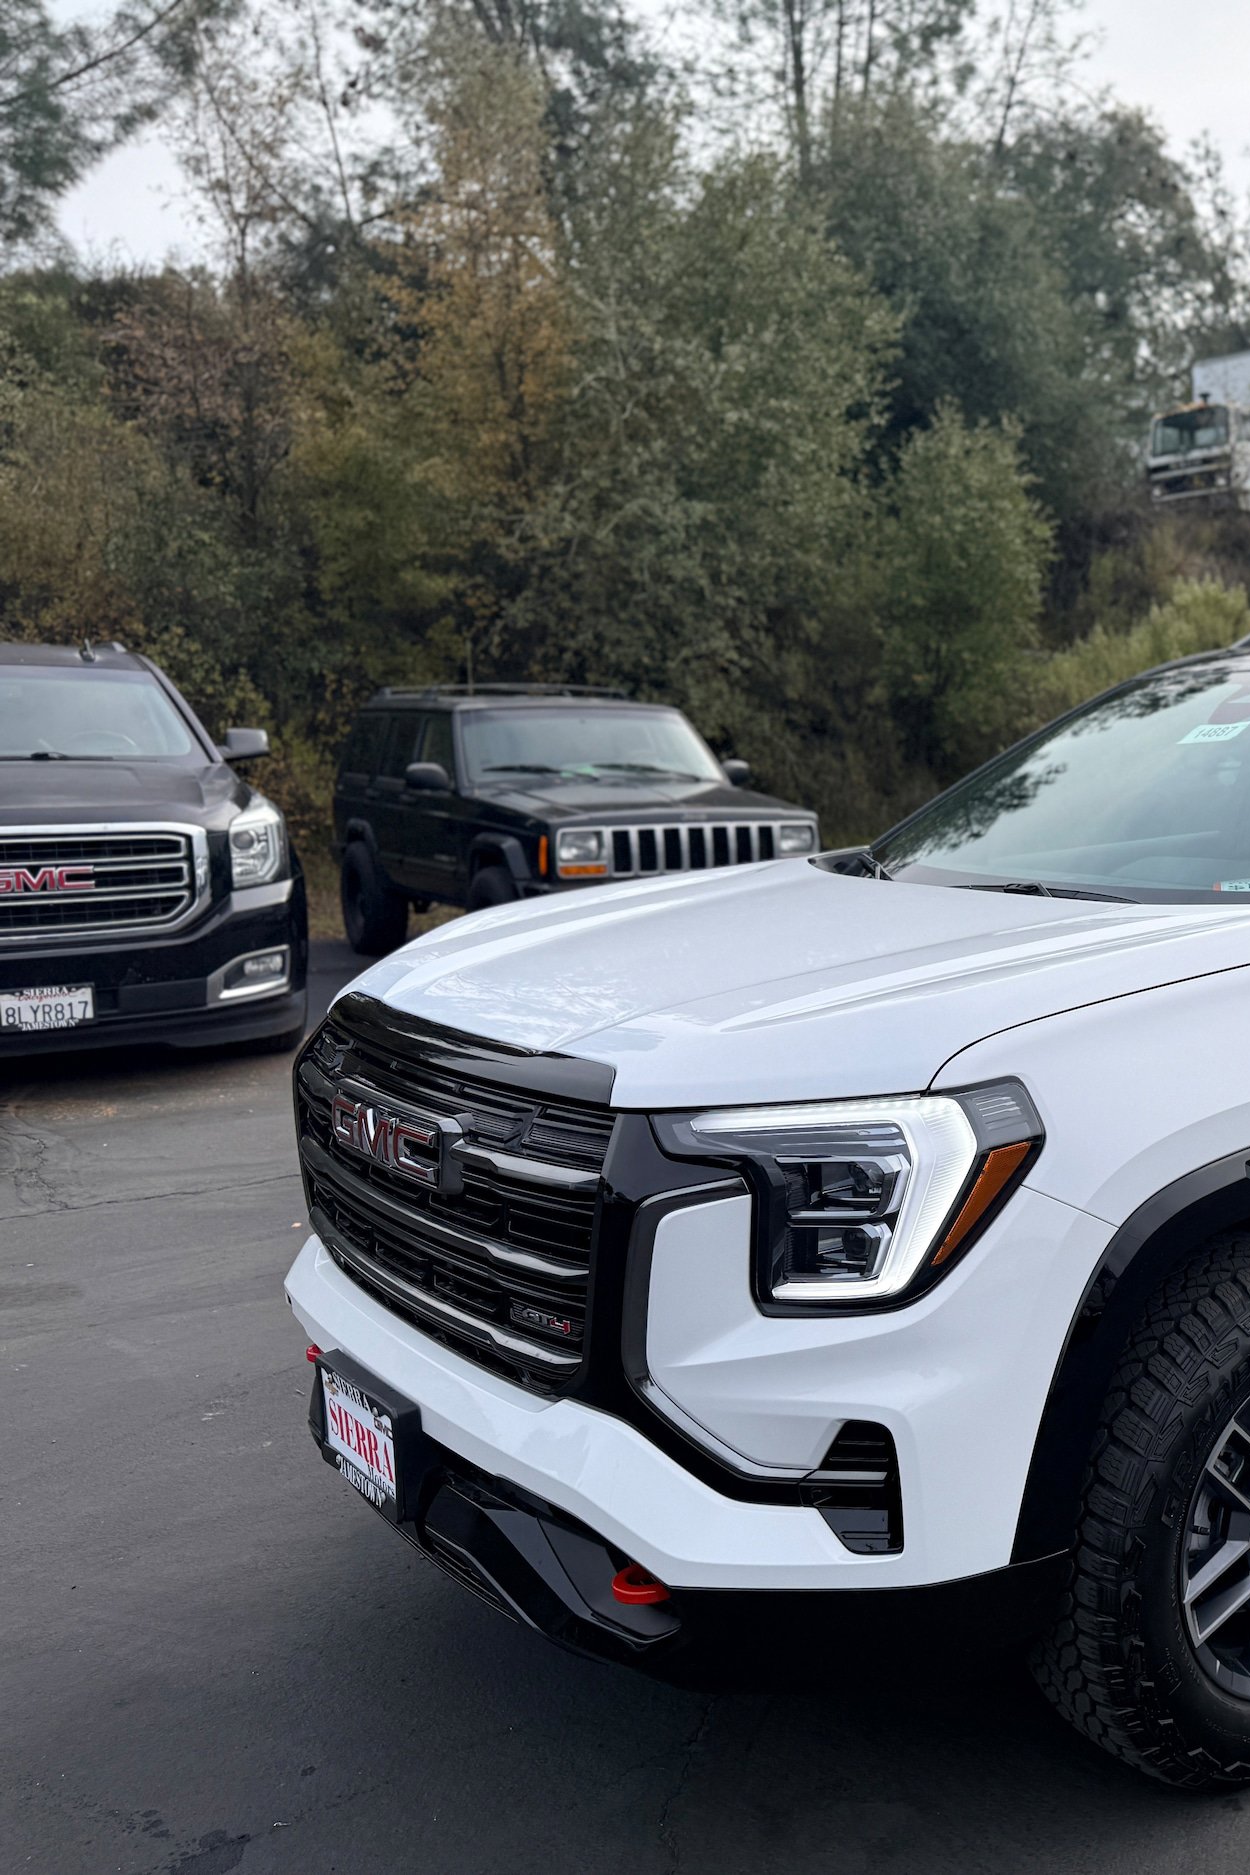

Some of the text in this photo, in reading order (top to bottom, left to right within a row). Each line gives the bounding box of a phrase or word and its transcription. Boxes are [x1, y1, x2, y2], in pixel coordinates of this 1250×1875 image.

[5, 1000, 89, 1026] 8LYR817
[22, 986, 69, 997] SIERRA
[331, 1093, 438, 1184] GMC
[331, 1371, 371, 1413] SIERRA
[328, 1397, 394, 1483] SIERRA
[339, 1455, 383, 1509] JAMESTOWN
